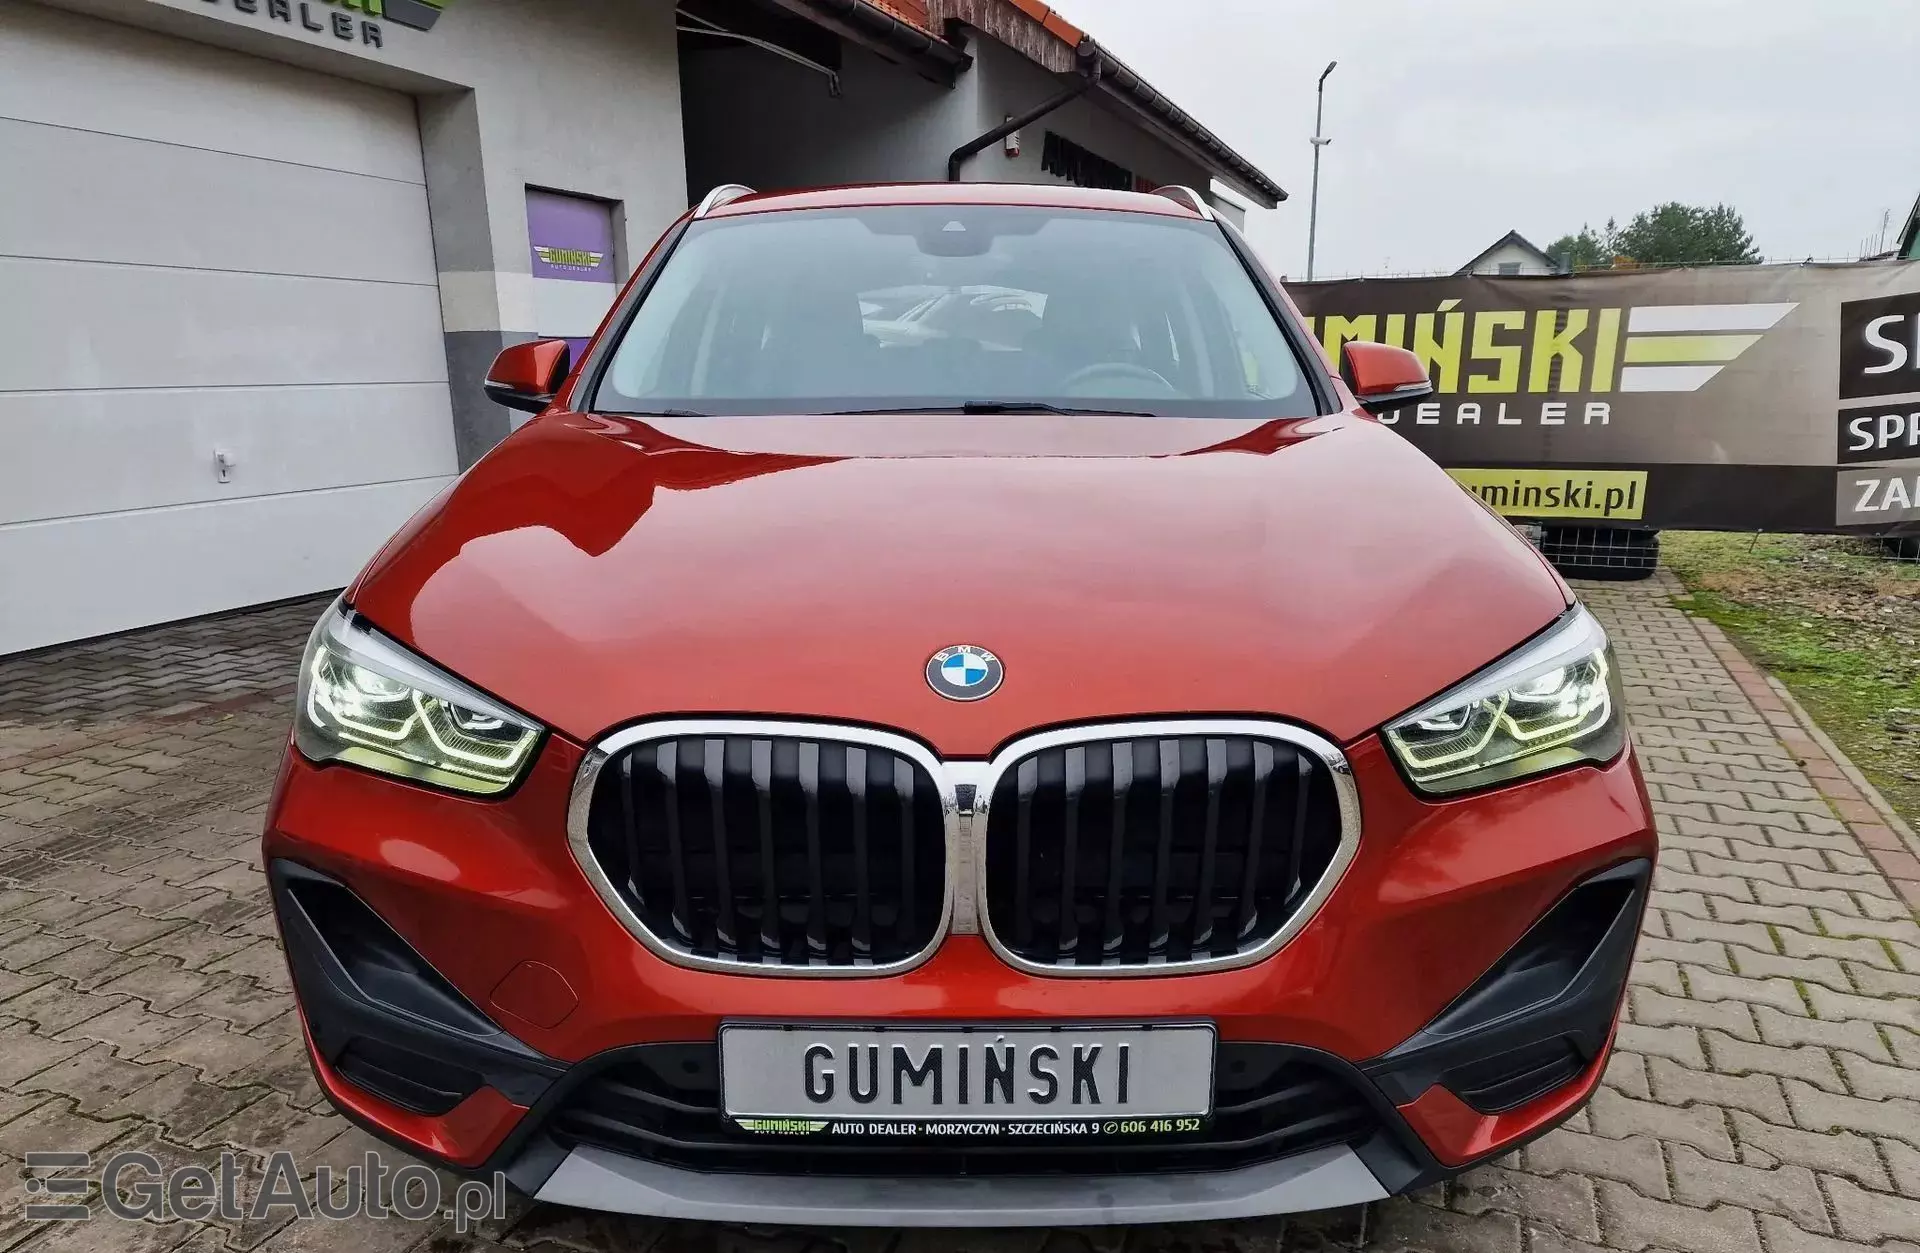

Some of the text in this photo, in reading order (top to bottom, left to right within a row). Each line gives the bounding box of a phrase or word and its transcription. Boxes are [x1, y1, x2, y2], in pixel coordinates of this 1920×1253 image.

[1864, 312, 1920, 374] S
[1854, 475, 1920, 513] ZA
[934, 646, 996, 662] BMW
[802, 1036, 1130, 1106] GUMIŃSKI
[754, 1119, 810, 1131] GUMIŃSKI
[831, 1118, 1200, 1136] AUTO DEALER MORZYCZYN SZCZECIŃSKA 9 606 416 952
